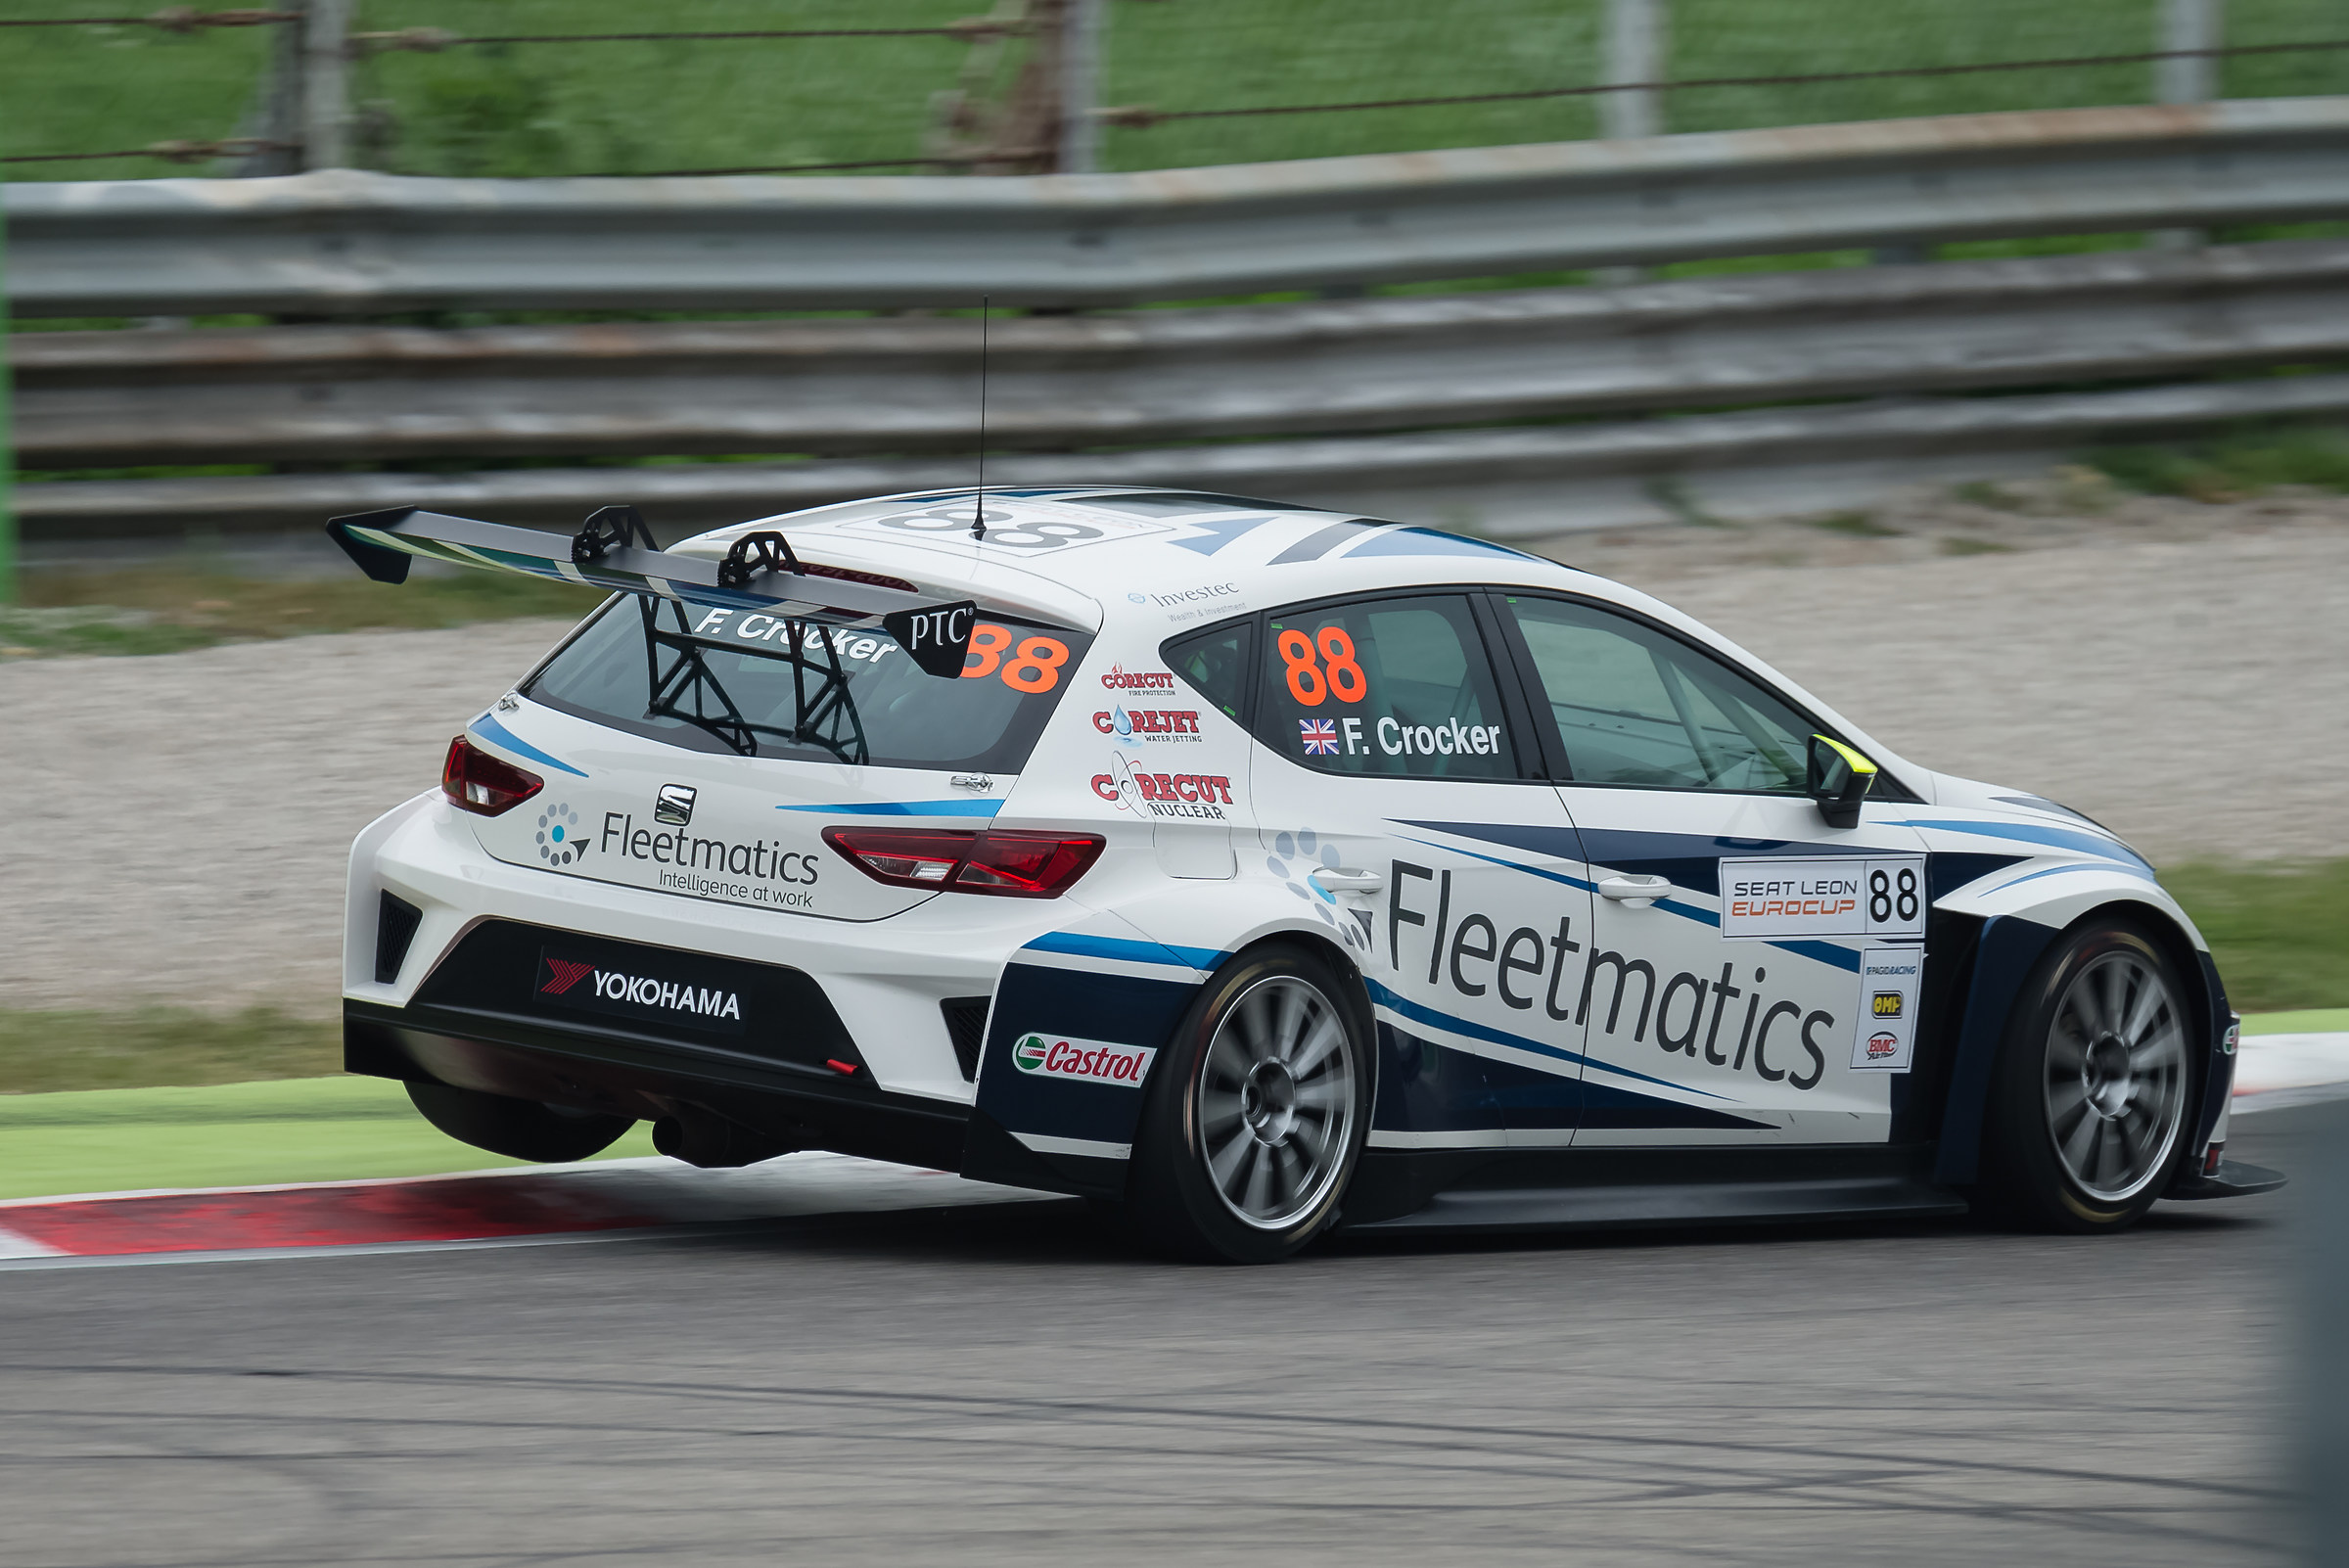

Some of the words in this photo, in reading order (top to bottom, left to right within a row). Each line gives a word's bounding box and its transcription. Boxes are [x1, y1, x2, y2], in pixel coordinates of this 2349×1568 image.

[1150, 581, 1240, 607] Investec
[694, 608, 733, 634] F.
[910, 608, 967, 650] PTC
[1168, 611, 1195, 623] Wealth
[1205, 602, 1247, 616] Investment
[1277, 626, 1367, 707] 88
[1173, 735, 1202, 744] JETTING
[1342, 717, 1370, 755] F.
[1377, 716, 1500, 756] Crocker
[1149, 804, 1226, 820] NUCLEAR
[601, 811, 819, 886] Fleetmatics
[659, 868, 749, 899] Intelligence
[753, 886, 769, 901] at
[772, 891, 813, 908] work
[1734, 882, 1796, 897] SEAT
[1801, 880, 1858, 895] LEON
[1869, 867, 1918, 924] 88
[1731, 899, 1856, 917] EUROCUP
[1389, 858, 1835, 1091] Fleetmatics
[594, 970, 740, 1020] YOKOHAMA
[1873, 996, 1902, 1013] OMP
[1045, 1041, 1146, 1082] Castrol
[1868, 1038, 1897, 1052] BMC
